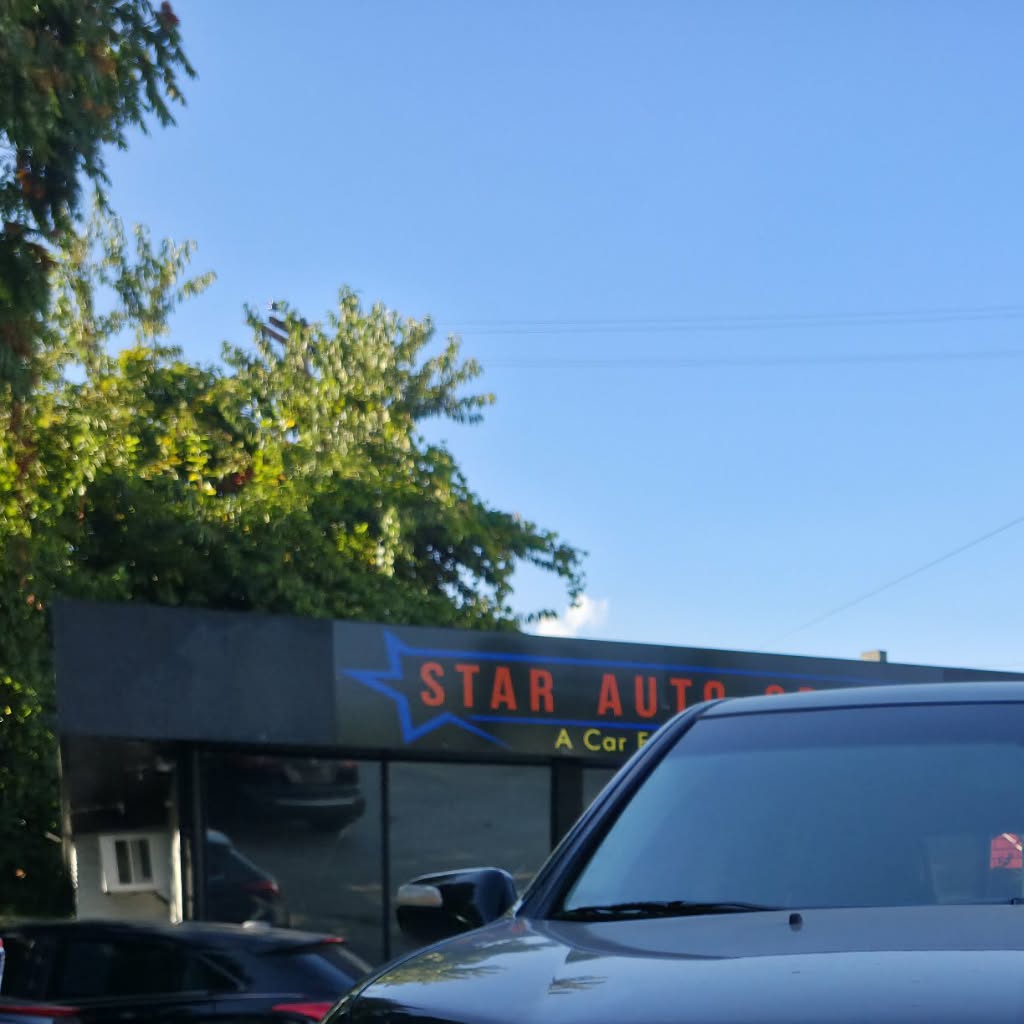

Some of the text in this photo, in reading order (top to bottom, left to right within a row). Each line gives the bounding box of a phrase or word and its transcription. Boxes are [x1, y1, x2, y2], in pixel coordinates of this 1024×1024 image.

[420, 661, 554, 713] STAR
[554, 728, 574, 750] A
[583, 728, 627, 752] Car
